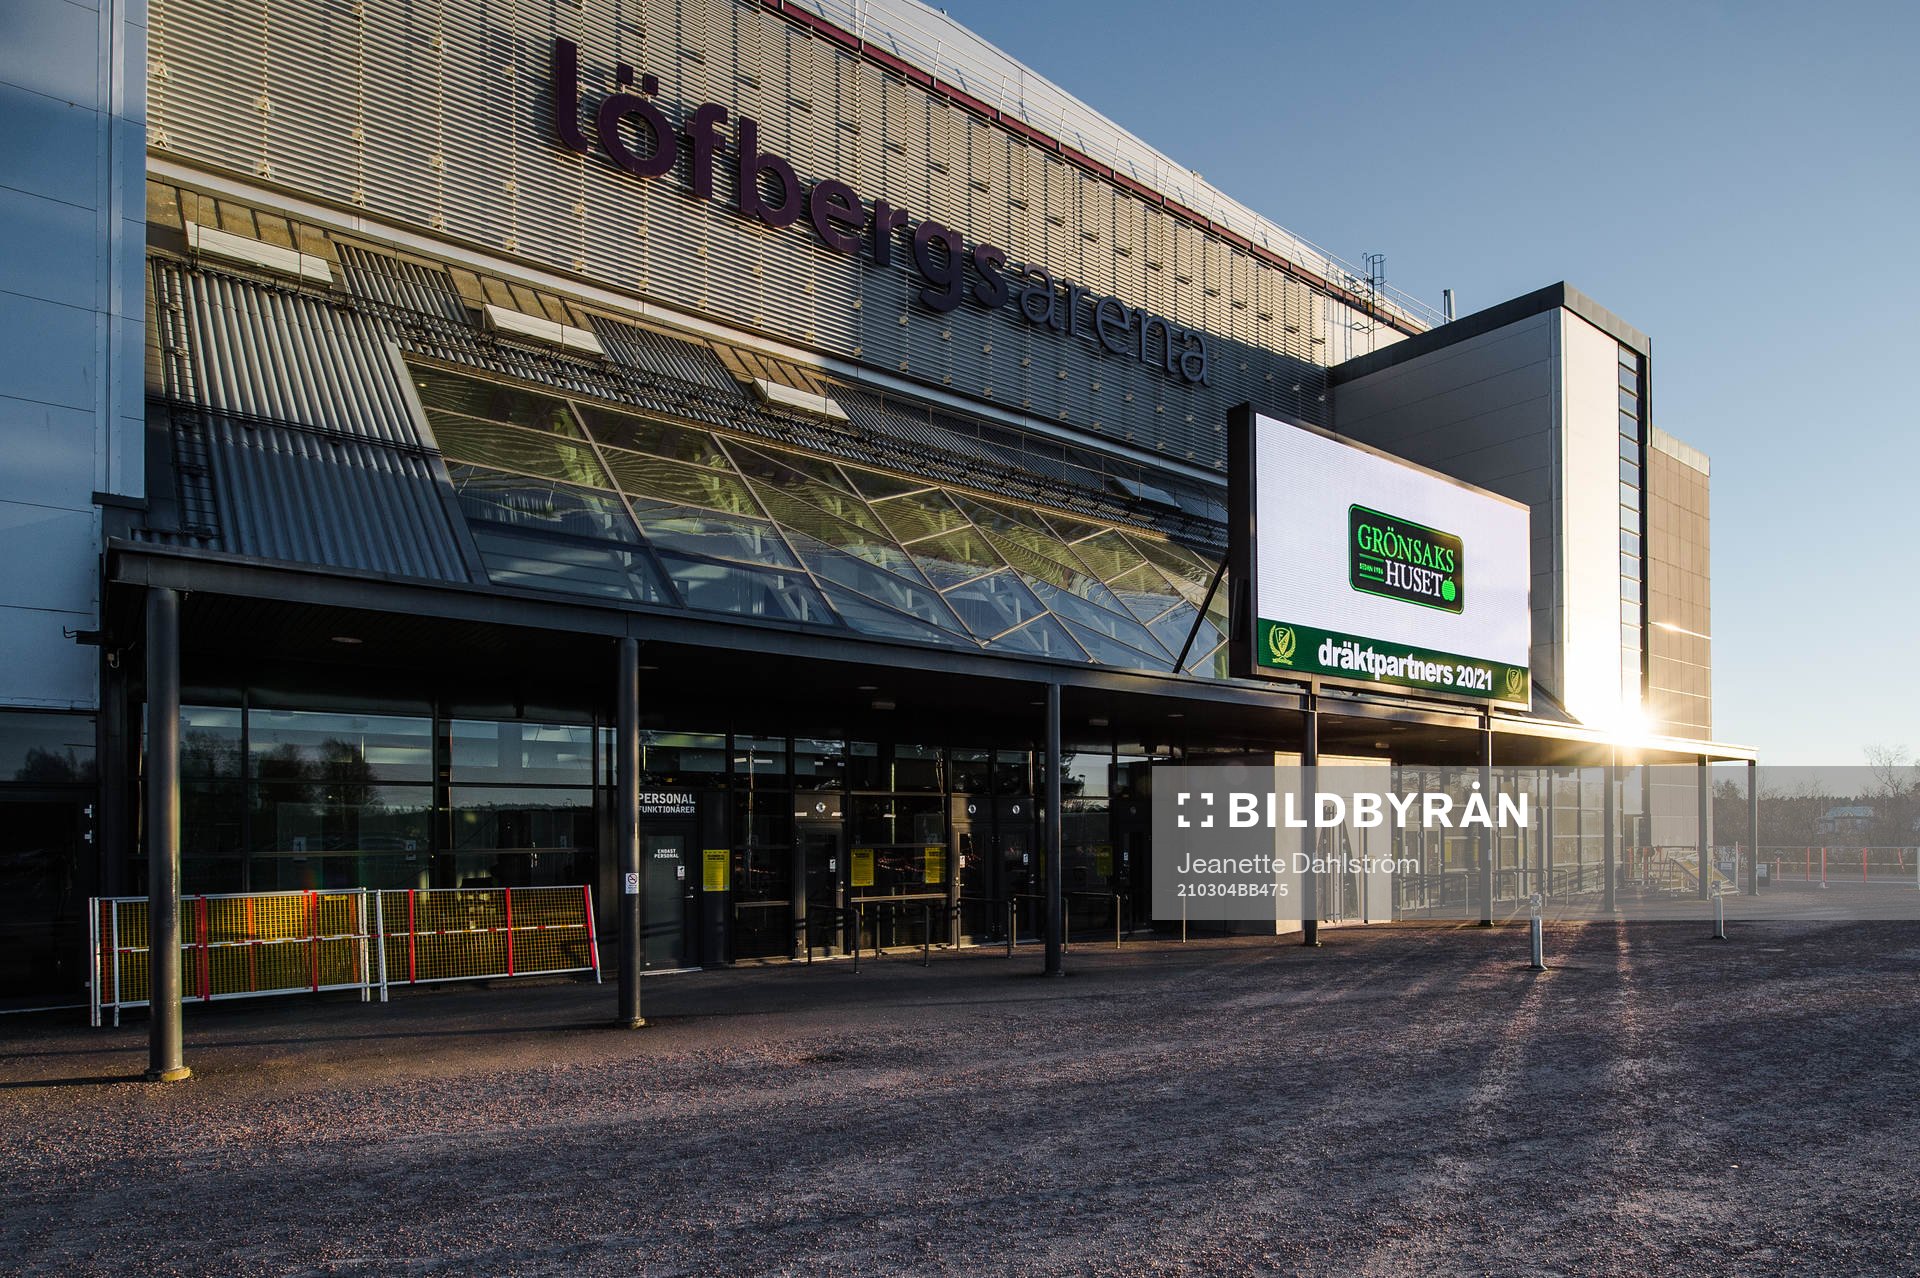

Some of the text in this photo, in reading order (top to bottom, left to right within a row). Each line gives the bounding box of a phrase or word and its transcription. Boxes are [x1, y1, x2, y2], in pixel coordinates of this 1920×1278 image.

[1357, 524, 1454, 573] GRÖNSAKS
[1384, 559, 1443, 598] HUSET
[1318, 637, 1493, 691] dräktpartners 20/21
[639, 793, 696, 804] PERSONAL
